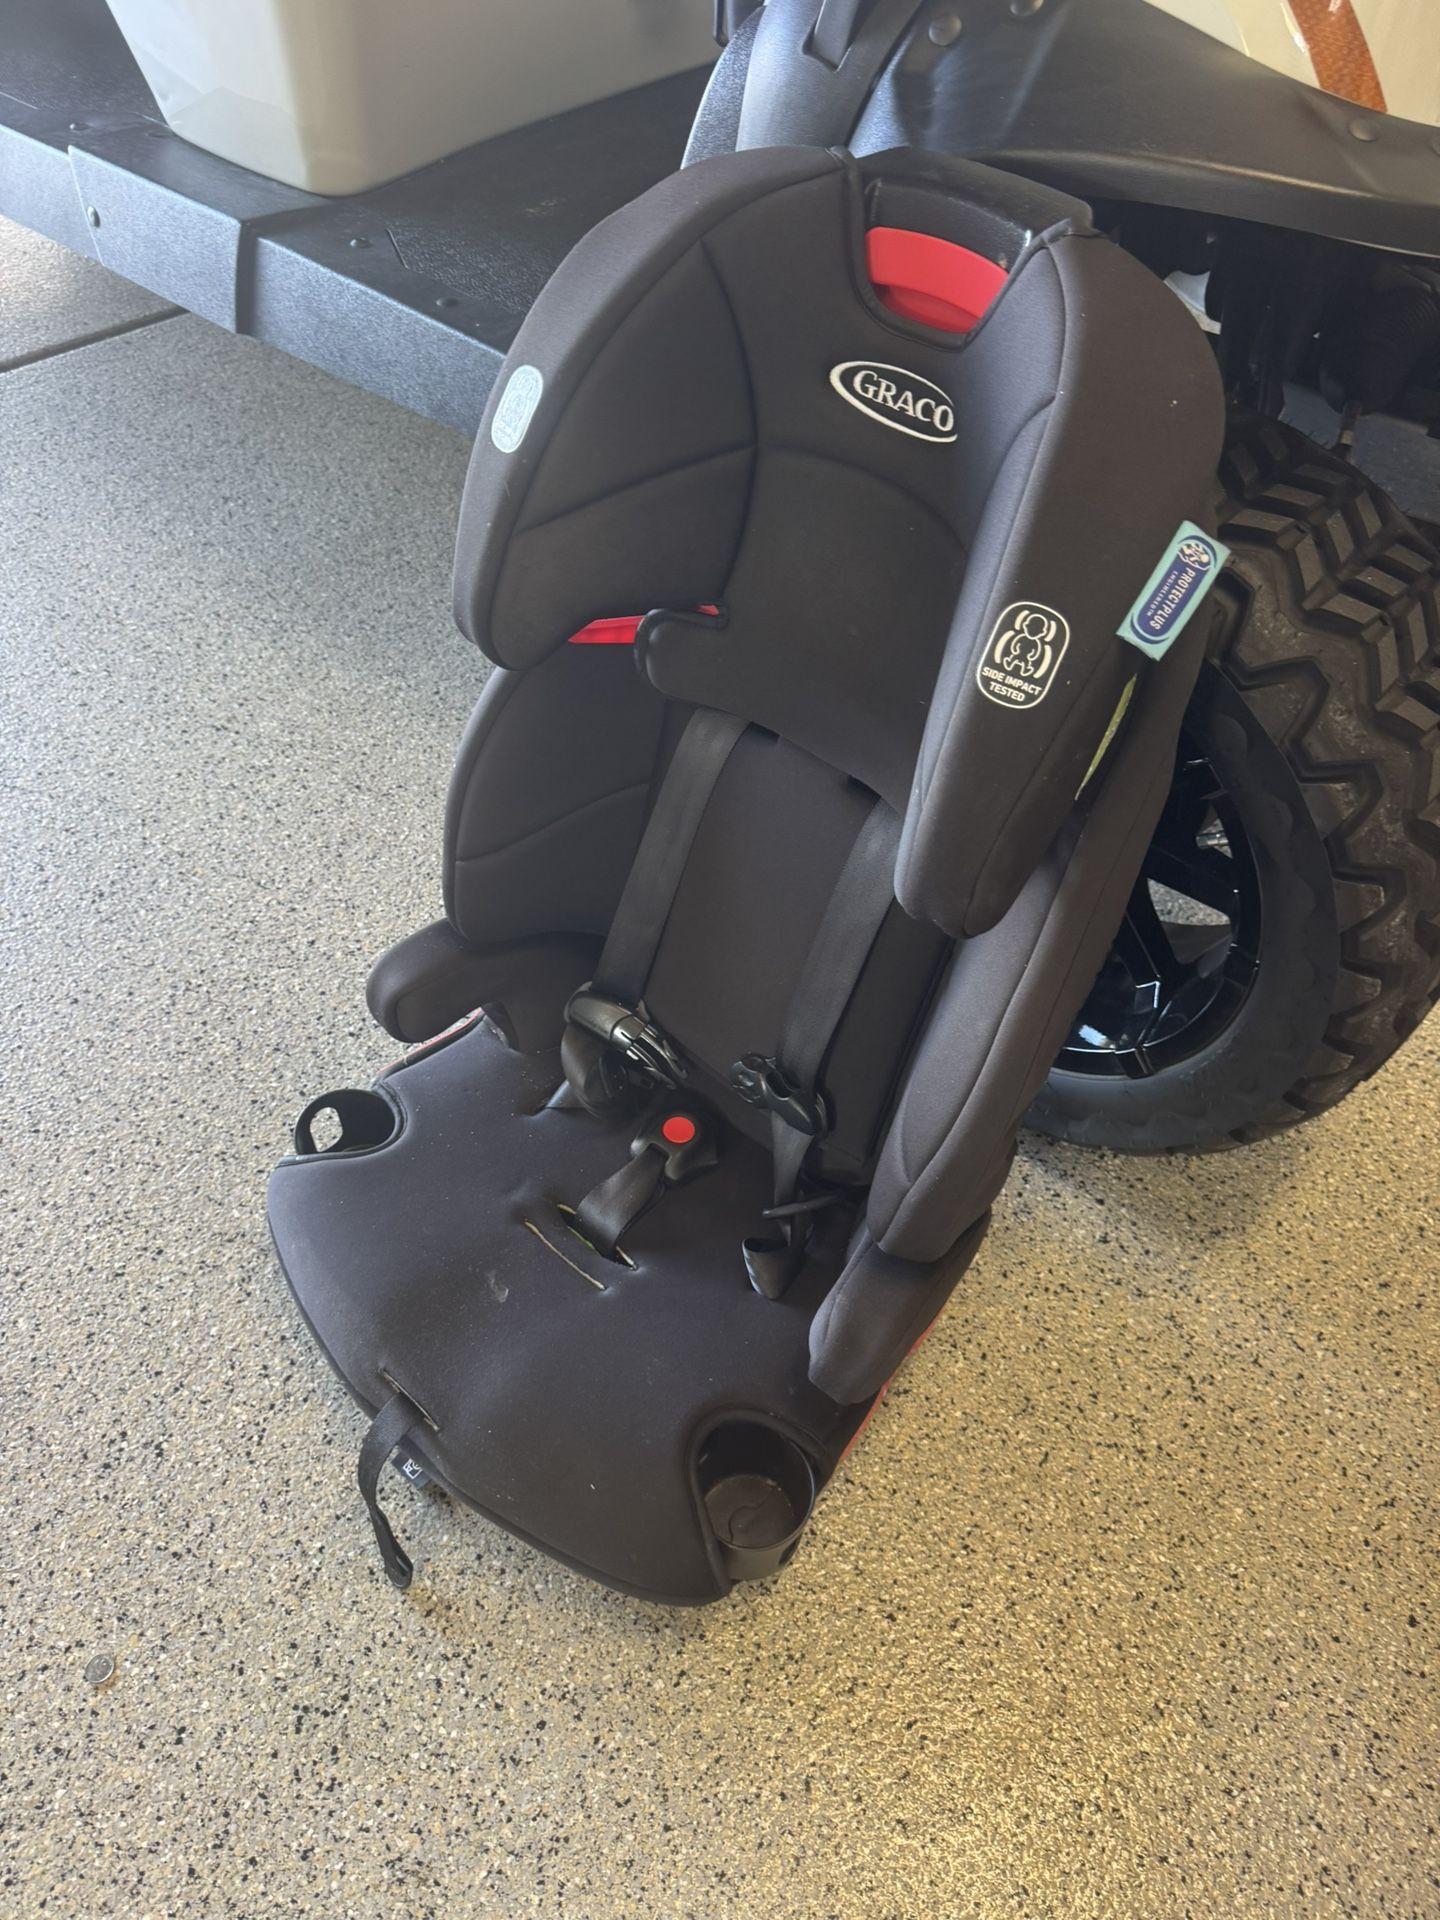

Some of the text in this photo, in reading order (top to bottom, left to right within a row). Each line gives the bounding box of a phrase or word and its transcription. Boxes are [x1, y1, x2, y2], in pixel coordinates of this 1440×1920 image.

[853, 370, 954, 431] GRACO
[1149, 567, 1196, 630] PROTECTPLUS
[982, 666, 1042, 695] SIDE IMPACT
[989, 681, 1026, 702] TESTED
